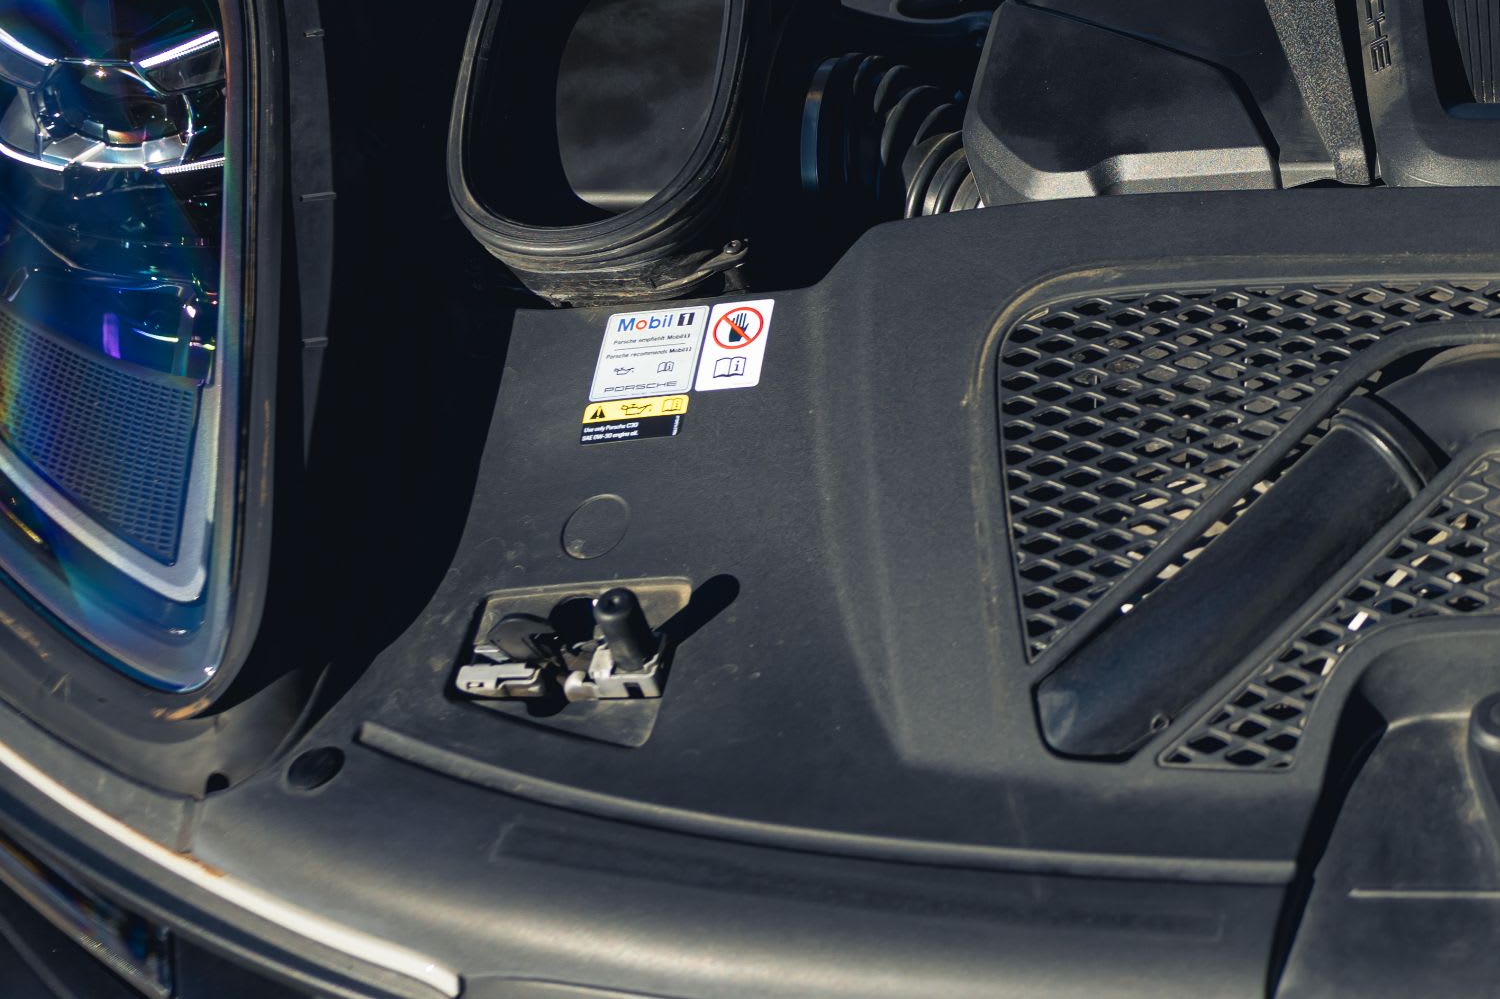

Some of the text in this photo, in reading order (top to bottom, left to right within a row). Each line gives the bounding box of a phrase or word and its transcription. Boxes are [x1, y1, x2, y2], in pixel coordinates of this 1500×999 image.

[617, 312, 696, 332] Mobil 1
[613, 337, 637, 345] Porsche
[606, 352, 630, 360] Porsche
[603, 381, 678, 393] PORSCHE
[583, 424, 594, 433] Use
[594, 424, 606, 433] only
[606, 422, 626, 431] Porsche
[581, 434, 593, 442] SAE
[612, 431, 630, 441] engine
